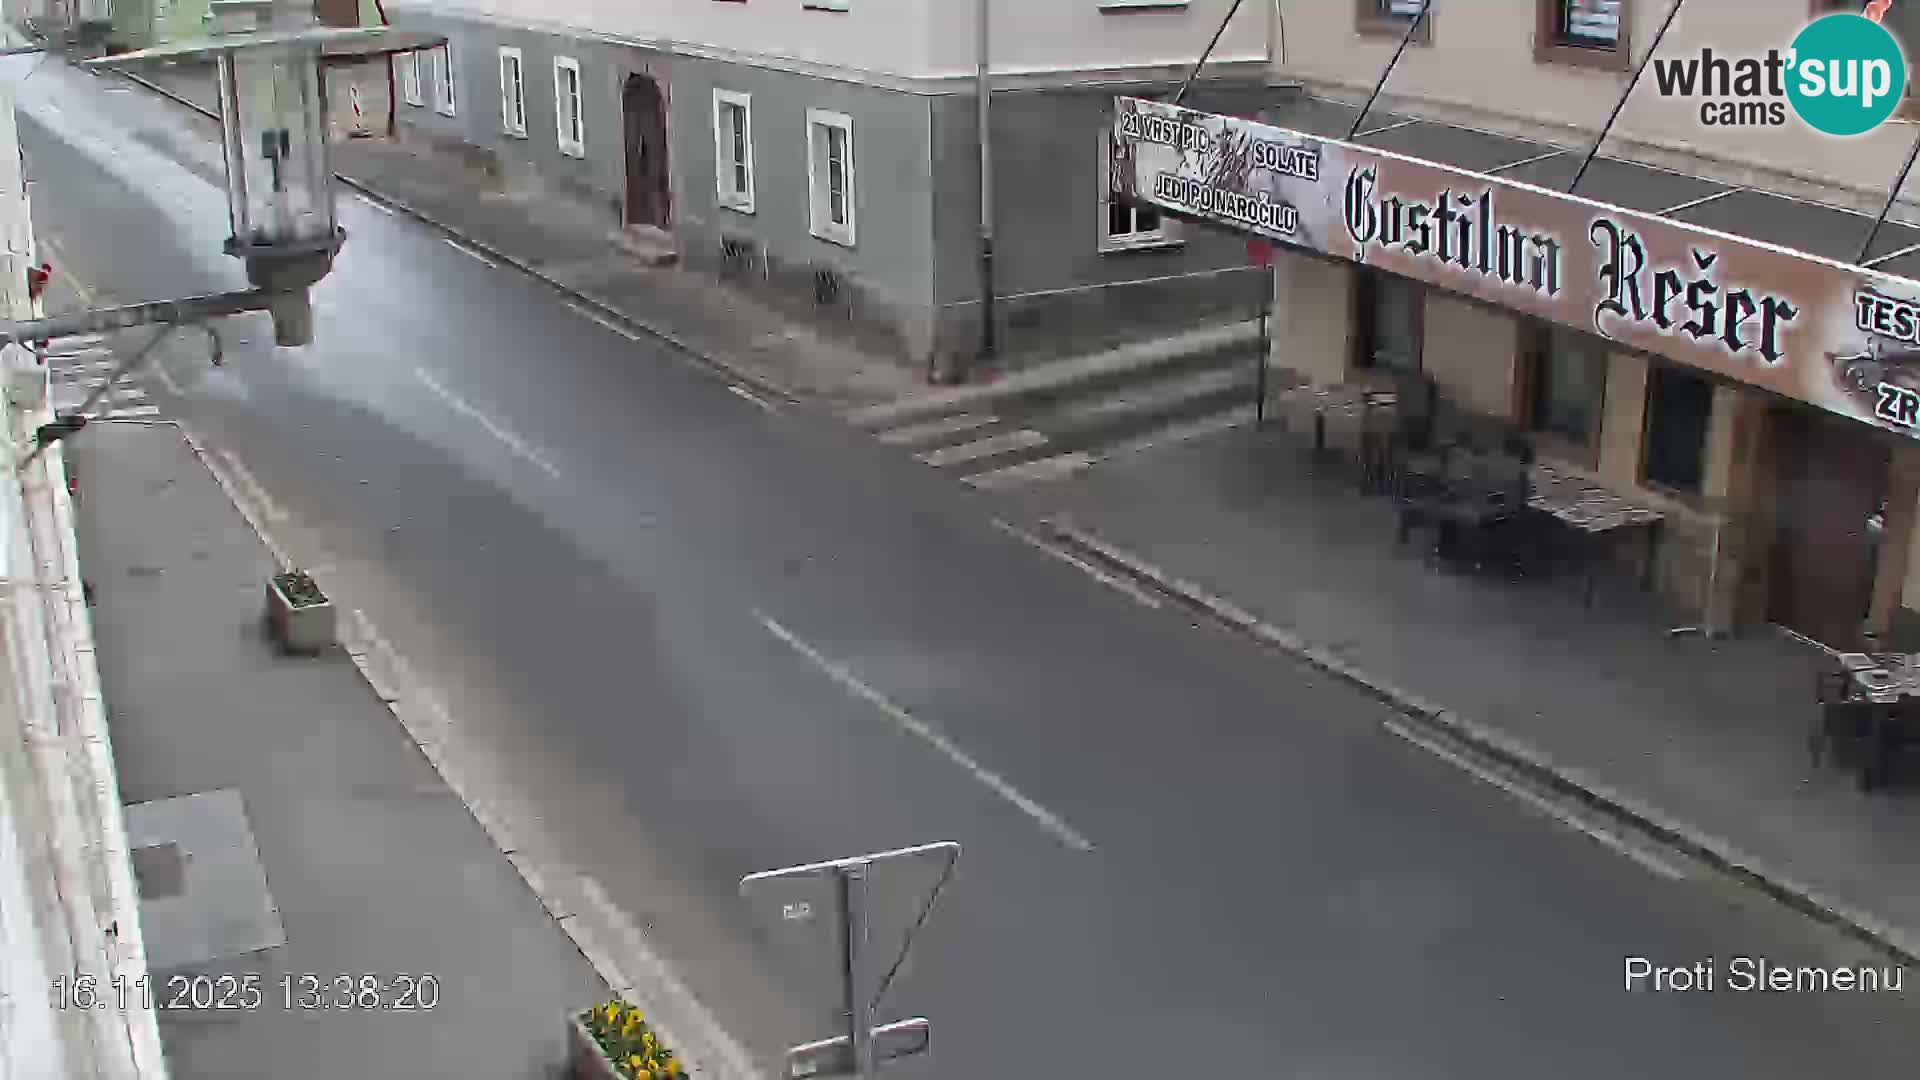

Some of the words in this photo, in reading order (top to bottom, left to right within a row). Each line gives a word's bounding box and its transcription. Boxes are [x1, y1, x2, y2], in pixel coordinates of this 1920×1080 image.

[1122, 112, 1141, 135] 21
[1142, 116, 1181, 146] VRST
[1253, 142, 1318, 179] SOLATE
[1155, 175, 1186, 203] JEDI
[1189, 181, 1213, 208] PO
[1214, 189, 1297, 233] NAROČILU
[1344, 162, 1562, 297] Gostilna
[1589, 218, 1800, 364] Rešer
